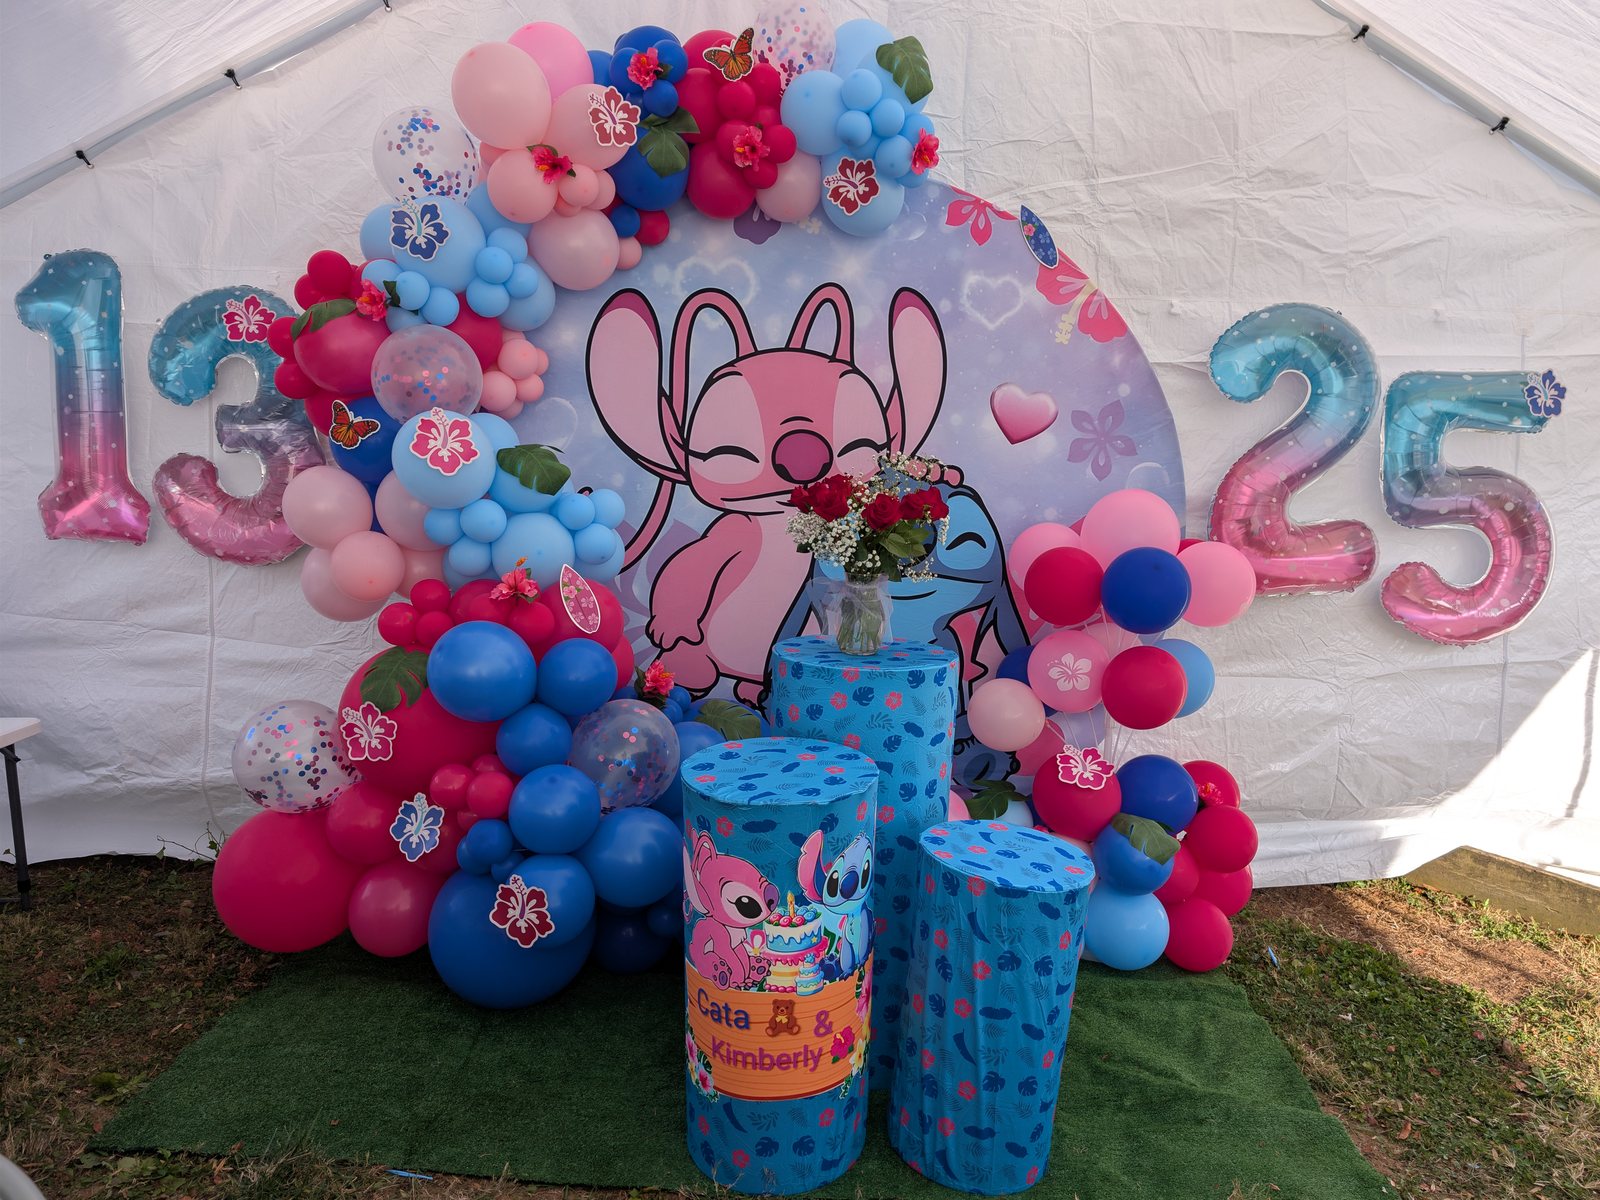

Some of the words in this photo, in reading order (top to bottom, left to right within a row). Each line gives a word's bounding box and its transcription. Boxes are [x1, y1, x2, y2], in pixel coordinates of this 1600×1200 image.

[14, 247, 327, 566] 13
[1208, 302, 1556, 648] 25
[697, 988, 750, 1030] Cata
[814, 1010, 833, 1037] &
[711, 1035, 823, 1072] Kimberly
